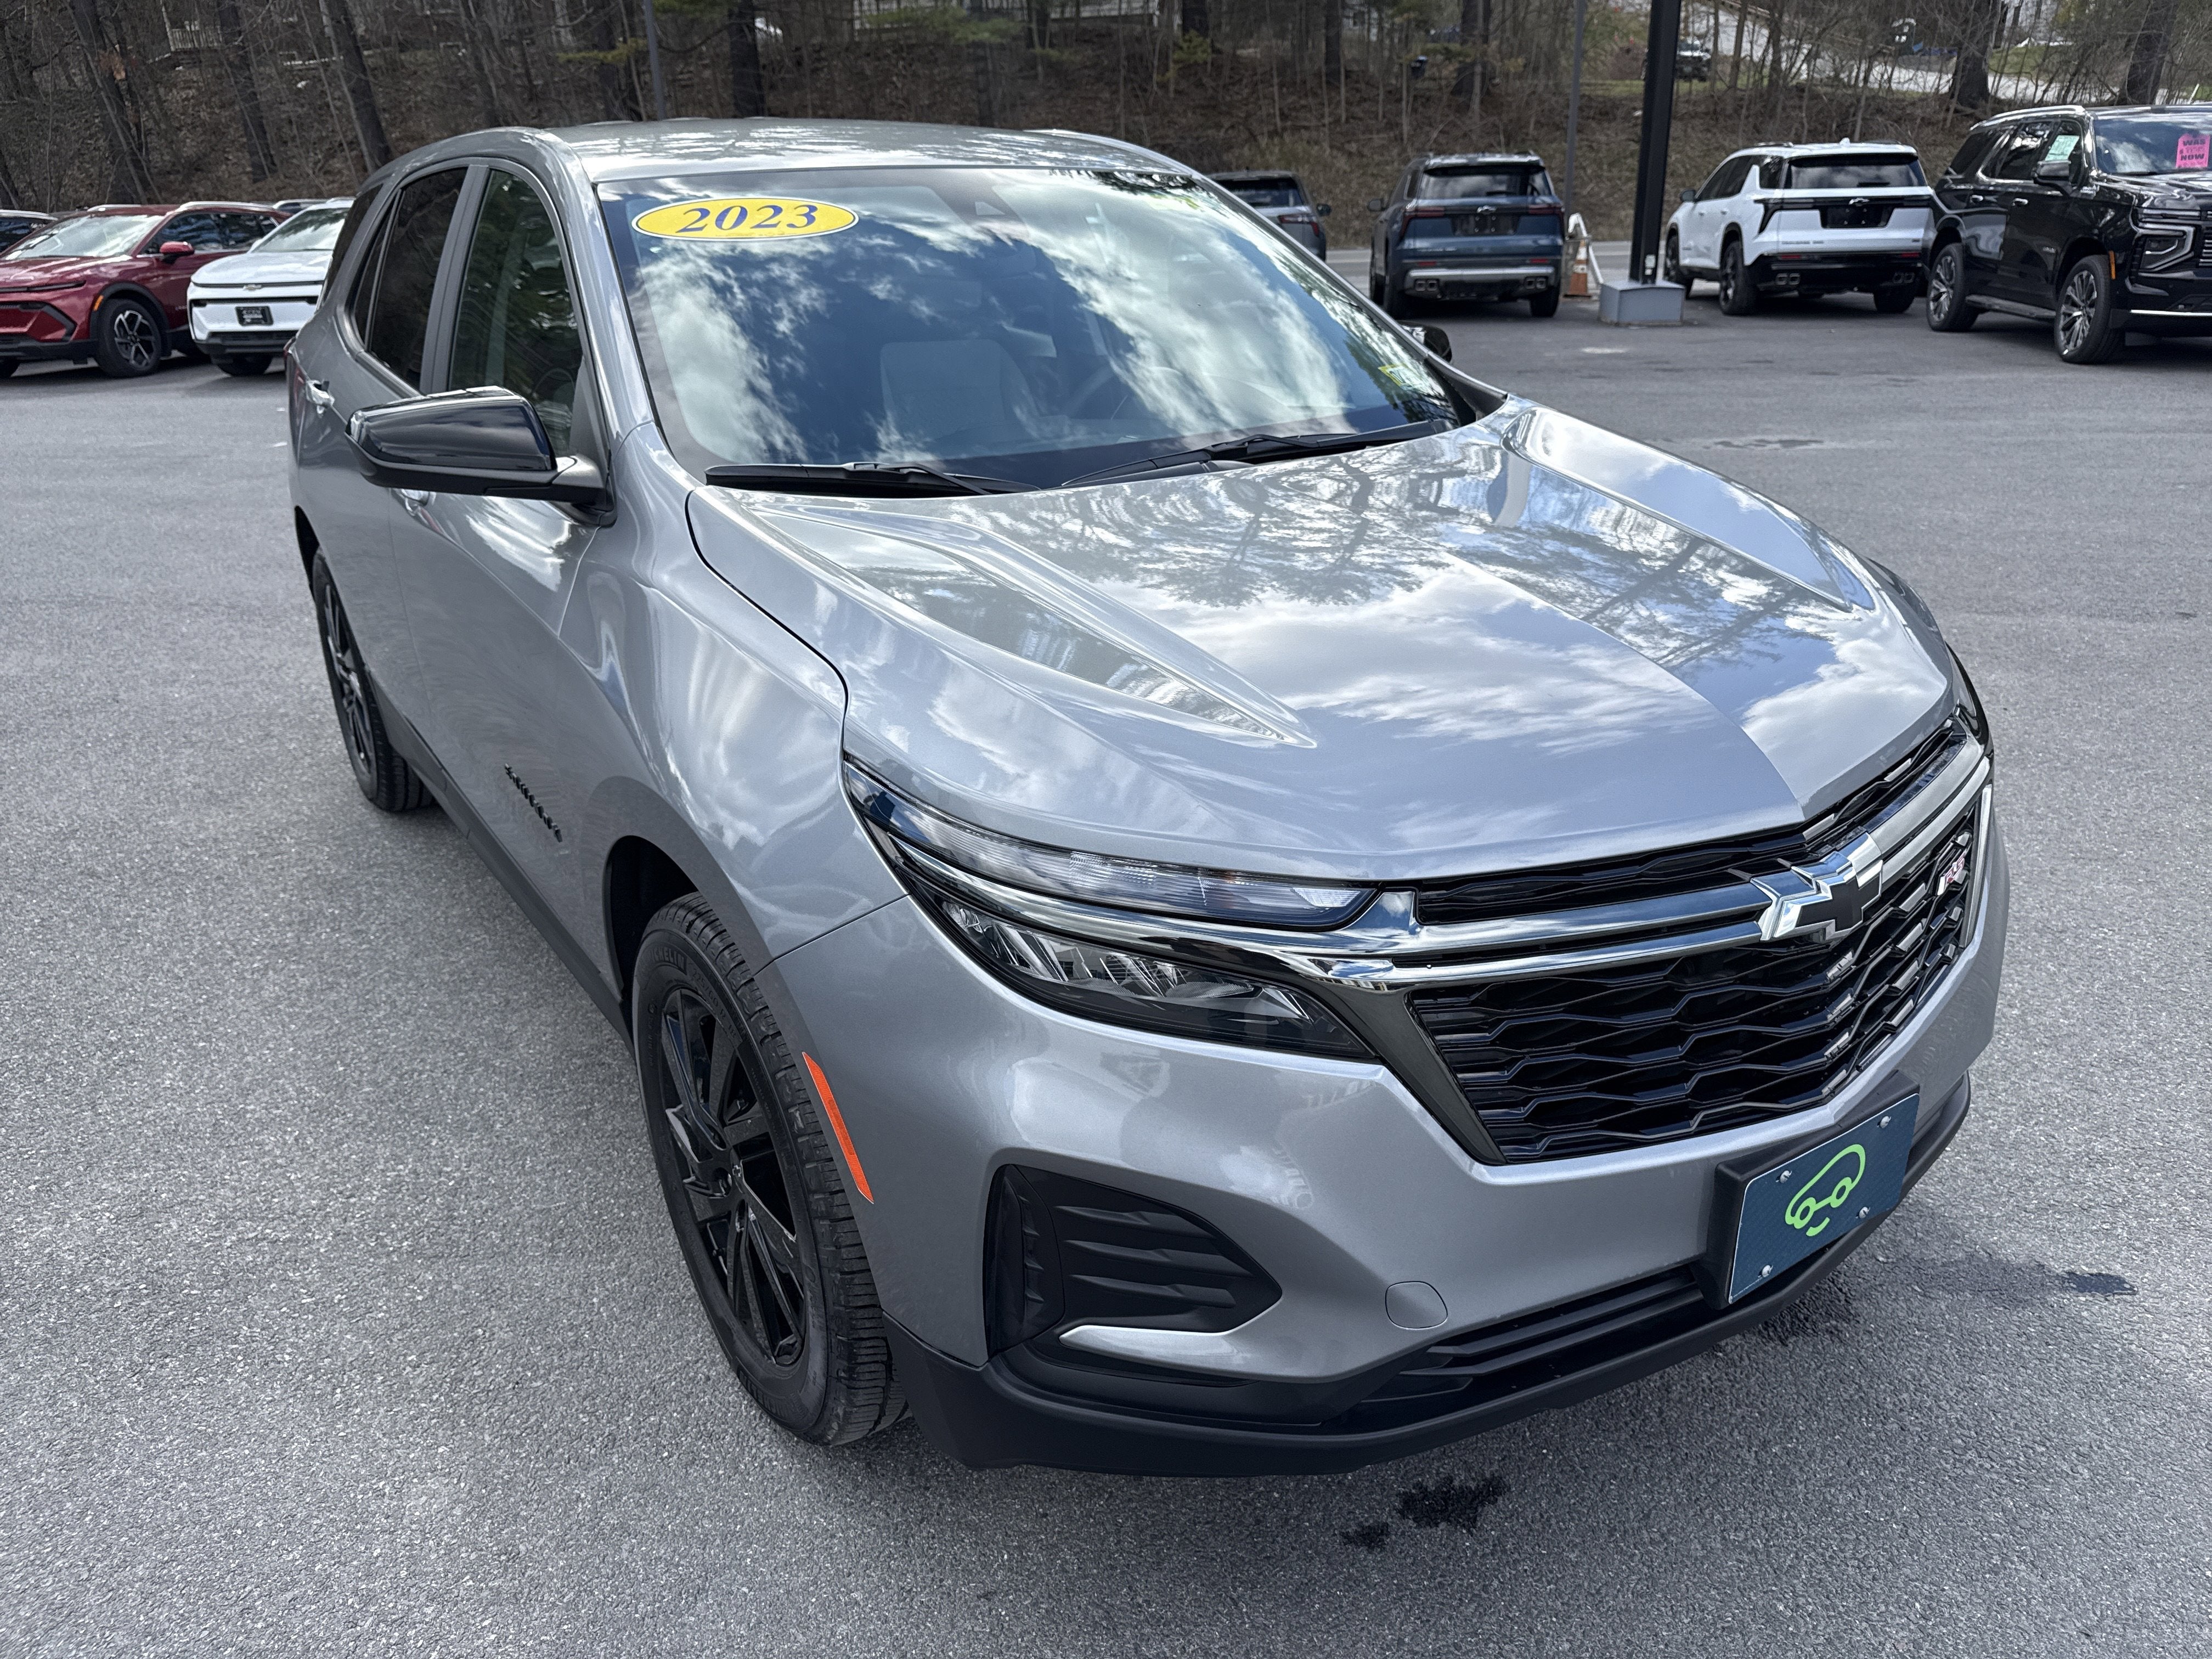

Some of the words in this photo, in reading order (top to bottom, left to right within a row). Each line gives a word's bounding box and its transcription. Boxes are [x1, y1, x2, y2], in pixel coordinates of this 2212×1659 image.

[675, 205, 818, 233] 2023
[646, 946, 685, 972] ICHELIN
[692, 967, 719, 1007] 225/60
[720, 1008, 726, 1019] R
[728, 1024, 736, 1039] 18
